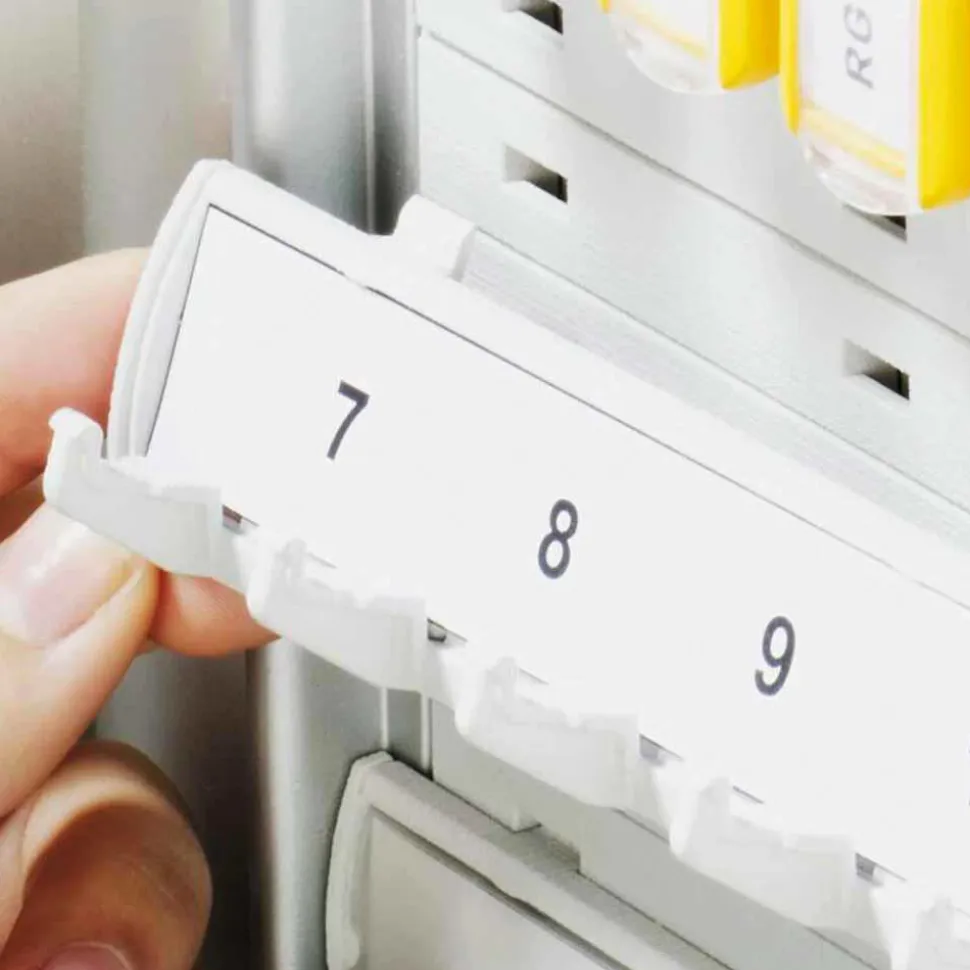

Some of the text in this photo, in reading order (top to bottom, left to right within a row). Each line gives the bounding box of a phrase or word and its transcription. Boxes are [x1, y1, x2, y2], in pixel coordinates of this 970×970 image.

[844, 4, 874, 89] RG
[326, 380, 370, 461] 7
[537, 498, 579, 580] 8
[754, 615, 796, 697] 9
